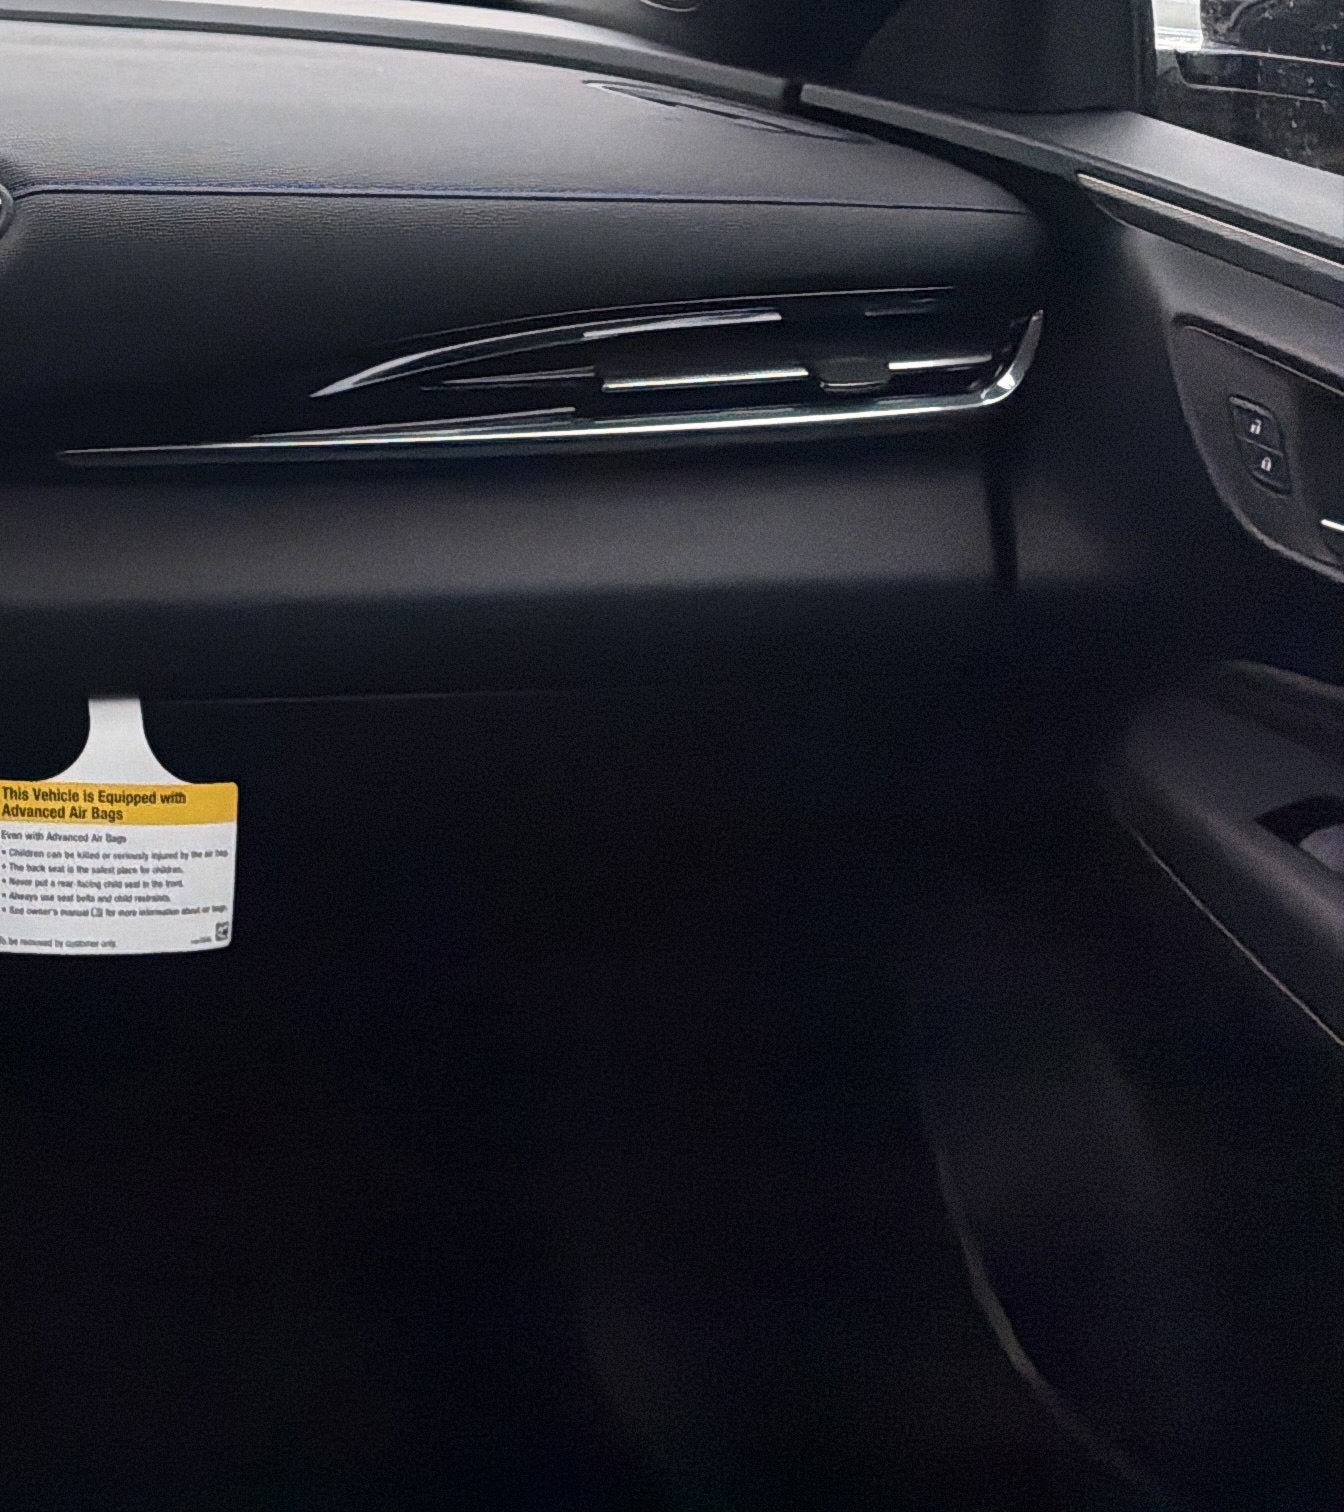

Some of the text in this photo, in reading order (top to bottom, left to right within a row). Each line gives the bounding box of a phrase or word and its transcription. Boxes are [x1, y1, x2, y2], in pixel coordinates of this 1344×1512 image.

[1, 786, 187, 807] This Vehicle is Equipped with
[1, 803, 124, 823] Advanced Air Bags
[1, 829, 127, 844] Even with Advanced Air Bags
[9, 848, 44, 858] Children
[46, 850, 62, 859] can
[64, 850, 74, 859] be
[76, 851, 100, 860] killed
[102, 852, 112, 860] or
[113, 851, 149, 862] seriously
[151, 851, 178, 861] injured
[180, 850, 189, 861] by
[9, 862, 24, 871] The
[26, 863, 46, 872] back
[76, 864, 89, 874] the
